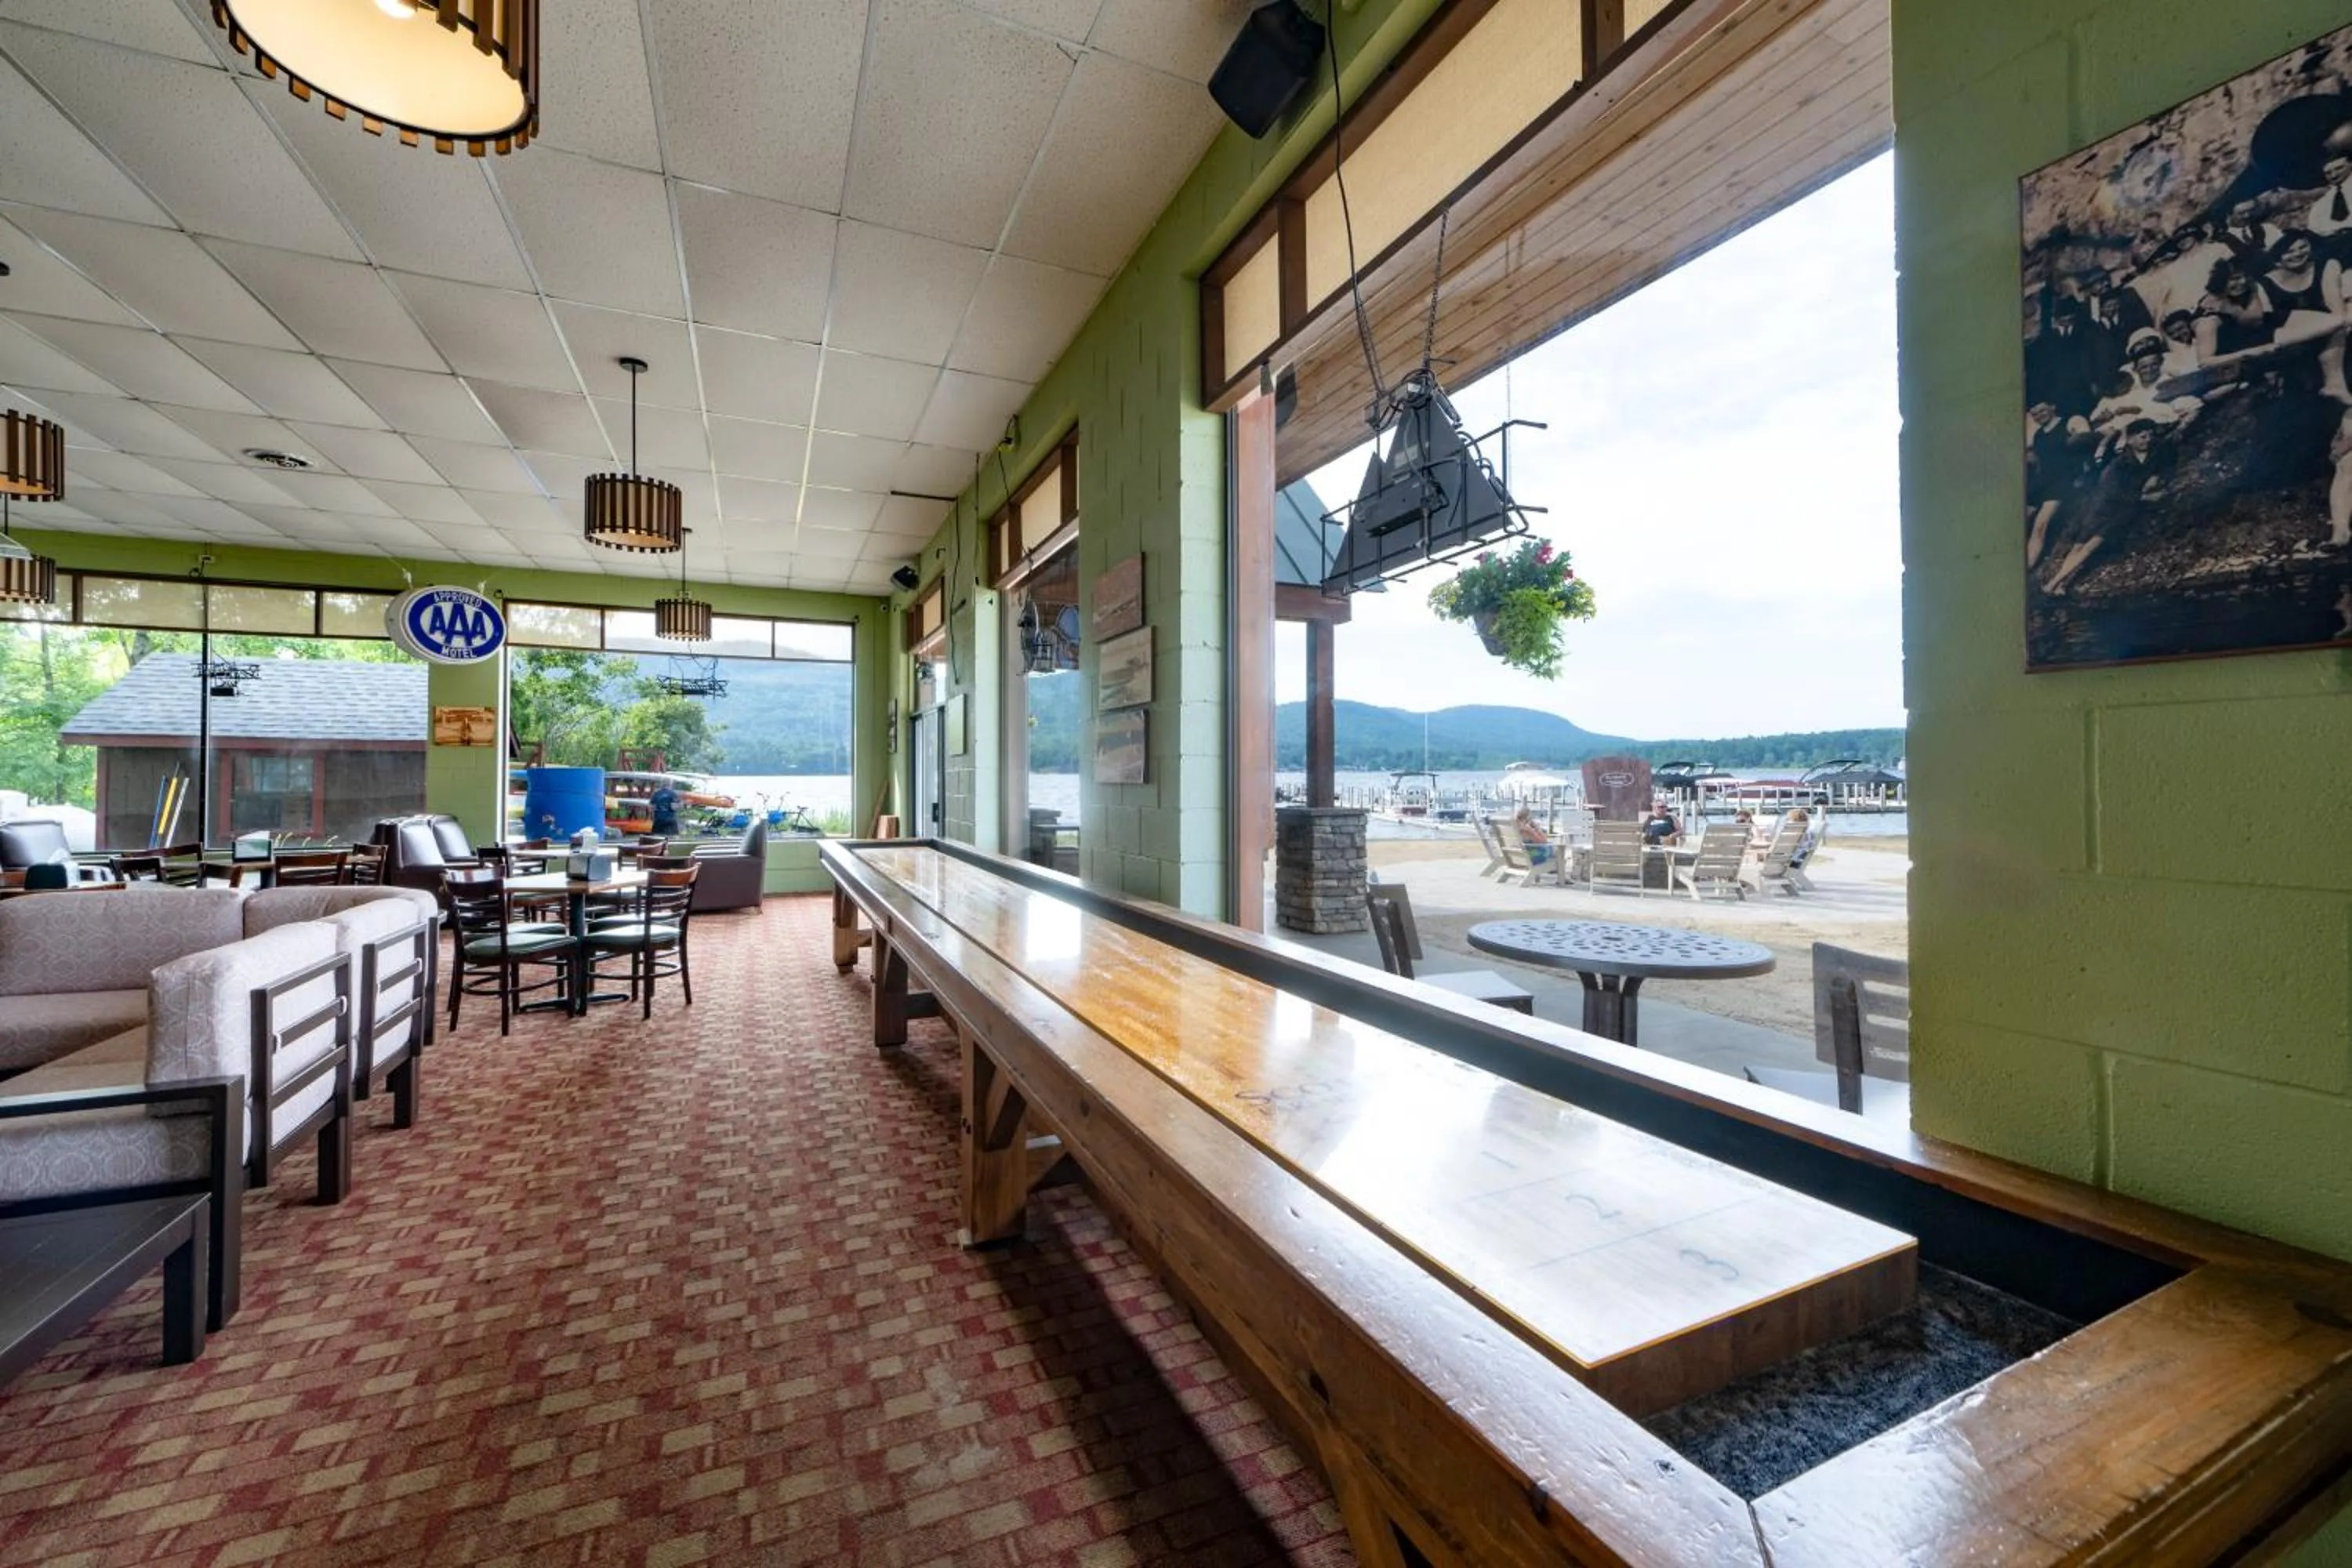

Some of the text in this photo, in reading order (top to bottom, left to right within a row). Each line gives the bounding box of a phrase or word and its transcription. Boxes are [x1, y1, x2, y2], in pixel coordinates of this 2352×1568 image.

[434, 591, 482, 607] APPROVED
[429, 603, 486, 647] AAA
[441, 648, 477, 659] MOTEL
[1565, 1193, 1623, 1220] 2
[1679, 1249, 1740, 1282] 3
